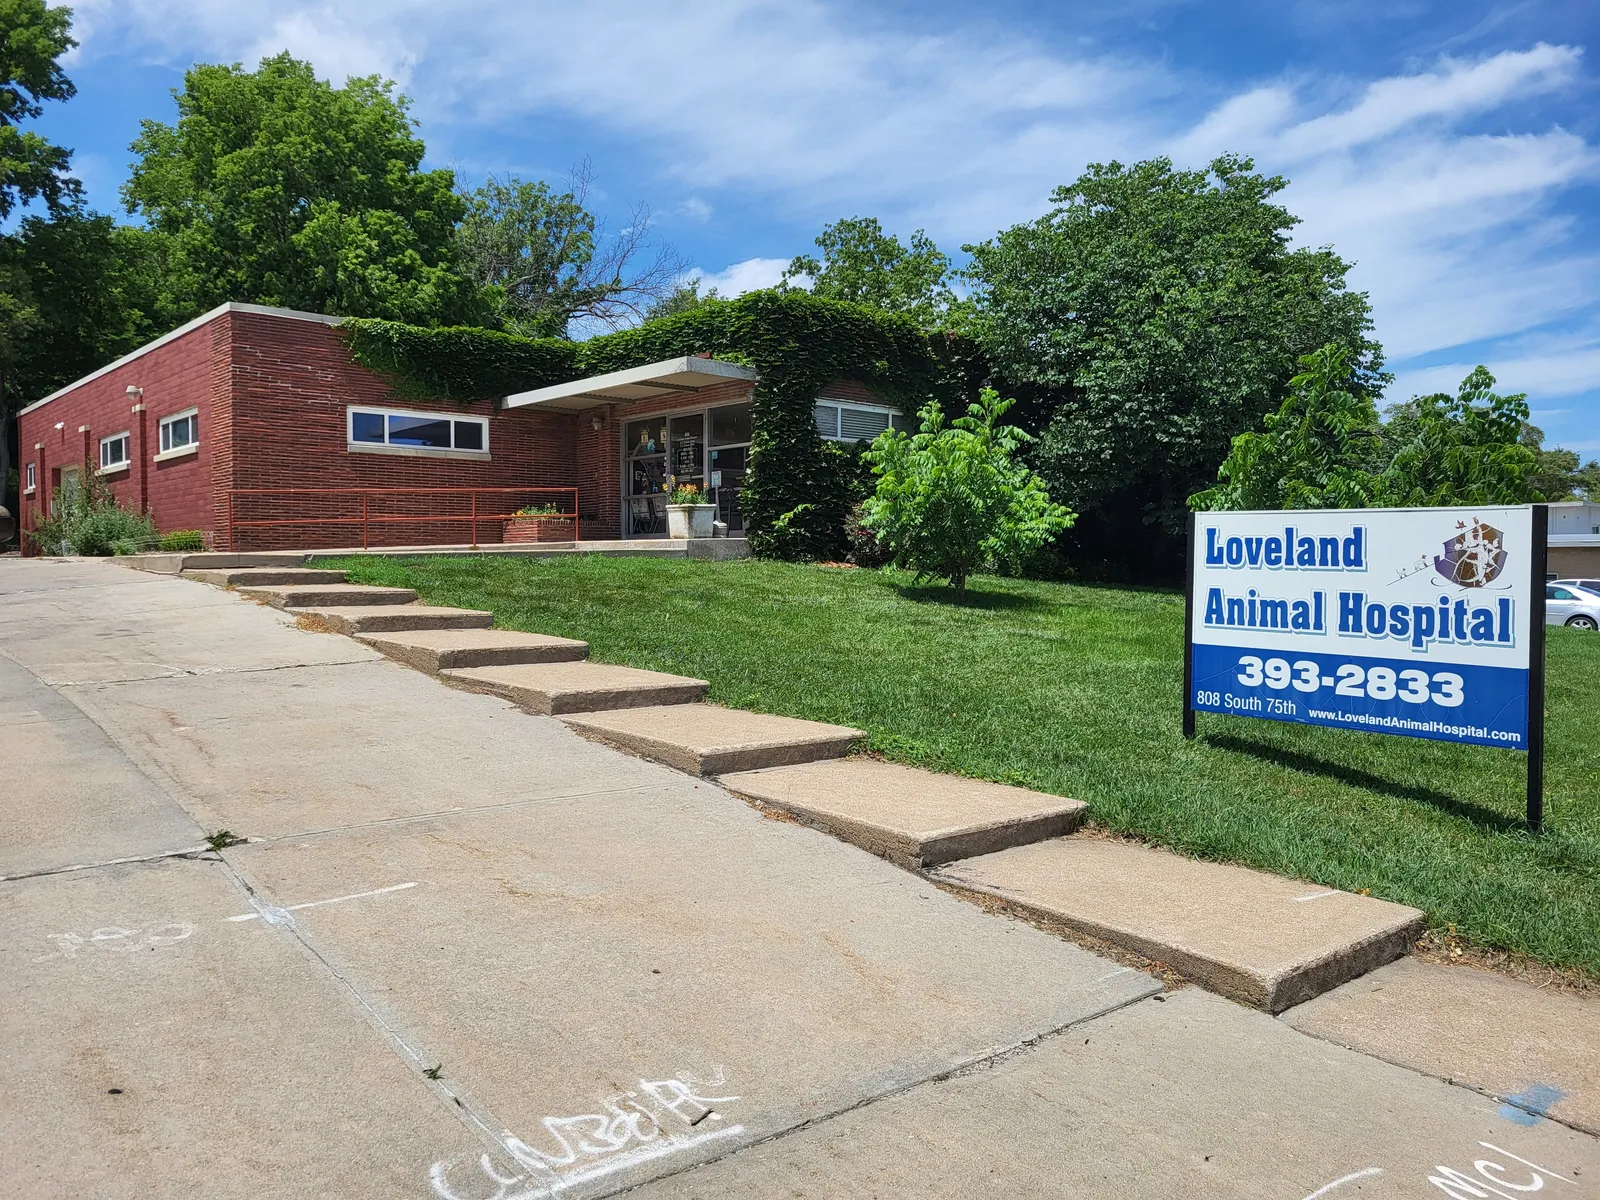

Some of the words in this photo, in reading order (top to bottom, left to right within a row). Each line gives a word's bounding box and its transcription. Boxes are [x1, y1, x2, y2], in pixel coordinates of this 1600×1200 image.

[1205, 525, 1367, 570] Loveland
[1204, 587, 1326, 635] Animal
[1336, 591, 1515, 652] Hospital
[1196, 690, 1220, 706] 808
[1224, 693, 1262, 712] South
[1266, 697, 1297, 715] 75th
[1237, 655, 1464, 708] 393-2833
[1308, 708, 1521, 742] www.LovelandAnimalHospital.com
